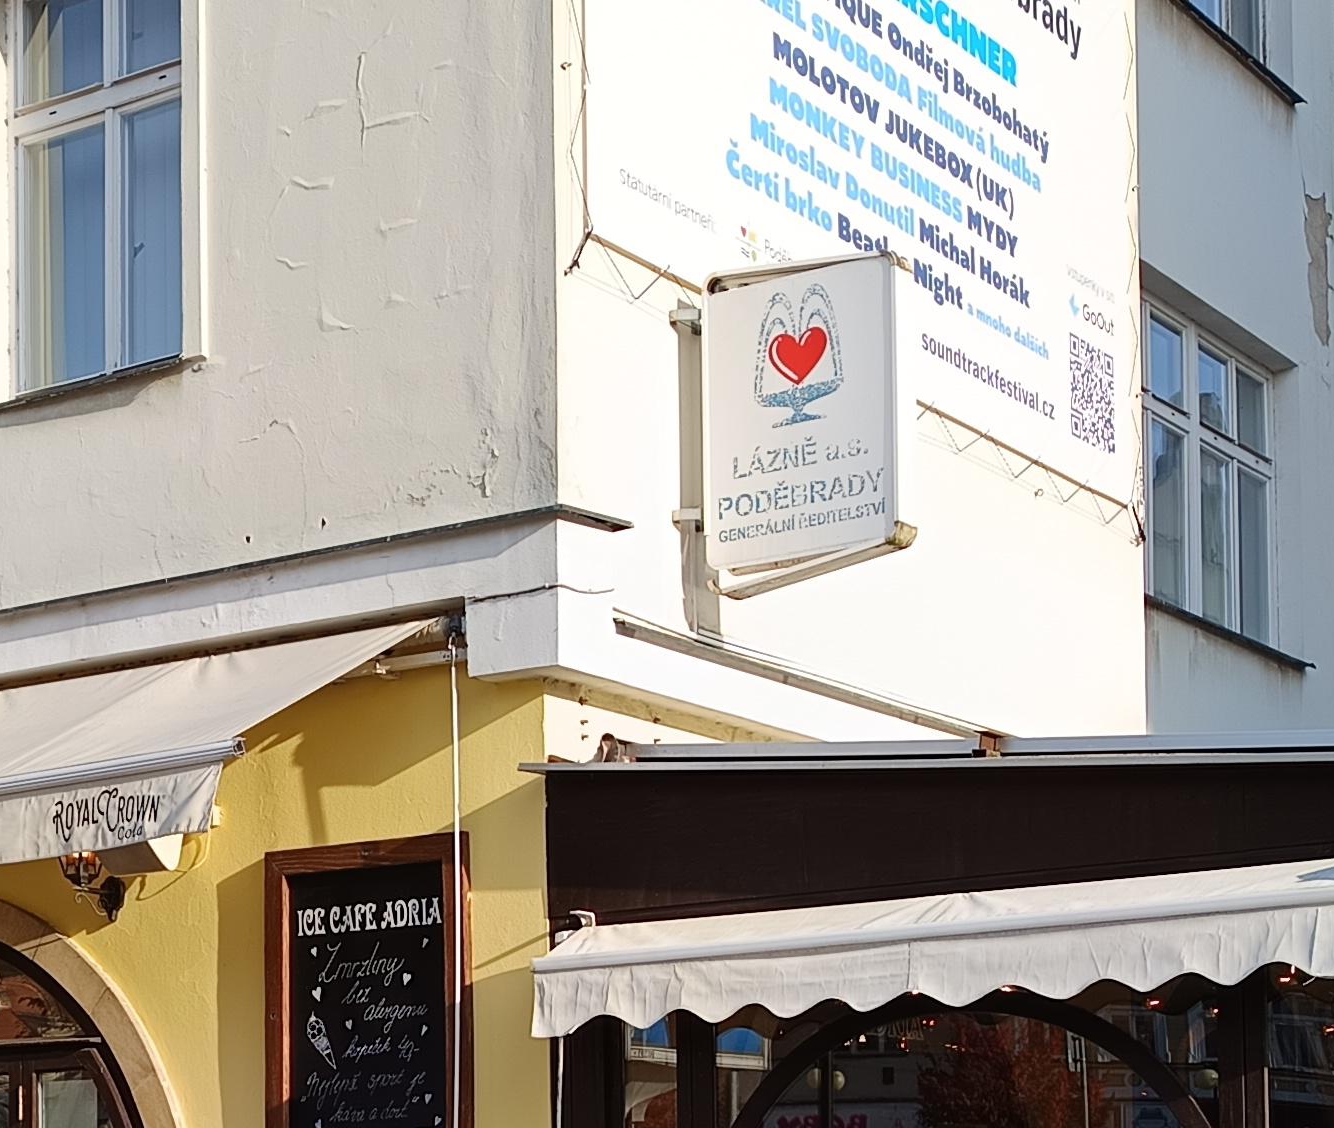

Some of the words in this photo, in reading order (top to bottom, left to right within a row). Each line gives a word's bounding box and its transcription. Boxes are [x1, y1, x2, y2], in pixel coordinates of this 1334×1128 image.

[894, 0, 1018, 88] RSCHNER
[772, 32, 880, 124] MOLOTOV
[885, 109, 973, 189] JUKEBOX
[976, 167, 1014, 221] (UK)
[811, 13, 913, 104] SVOBODA
[917, 85, 986, 154] Filmová
[989, 133, 1042, 193] hudba
[887, 22, 950, 94] Ondřej
[953, 67, 1050, 164] Brzobohatý
[769, 76, 864, 159] MONKEY
[870, 141, 963, 224] BUSINESS
[967, 205, 1018, 258] MYDY
[726, 138, 780, 203] Čerti
[785, 178, 833, 232] brko
[913, 257, 963, 310] Night
[749, 112, 840, 190] Miroslav
[845, 171, 915, 237] Donutil
[918, 218, 975, 275] Michal
[979, 256, 1030, 308] Horák
[967, 302, 973, 316] a
[976, 308, 1011, 338] mnoho
[1082, 303, 1115, 336] GoOut
[921, 333, 1056, 420] soundtrackfestival.cz
[733, 435, 817, 480] LÁZNĚ
[719, 467, 884, 521] PODĚBRADY
[719, 514, 796, 543] GENERÁLNÍ
[53, 797, 99, 843] ROYAL
[97, 787, 160, 833] CROWN
[117, 825, 143, 841] Cola
[297, 907, 326, 937] ICE
[329, 902, 378, 934] CAFE
[381, 897, 443, 929] ADRIA
